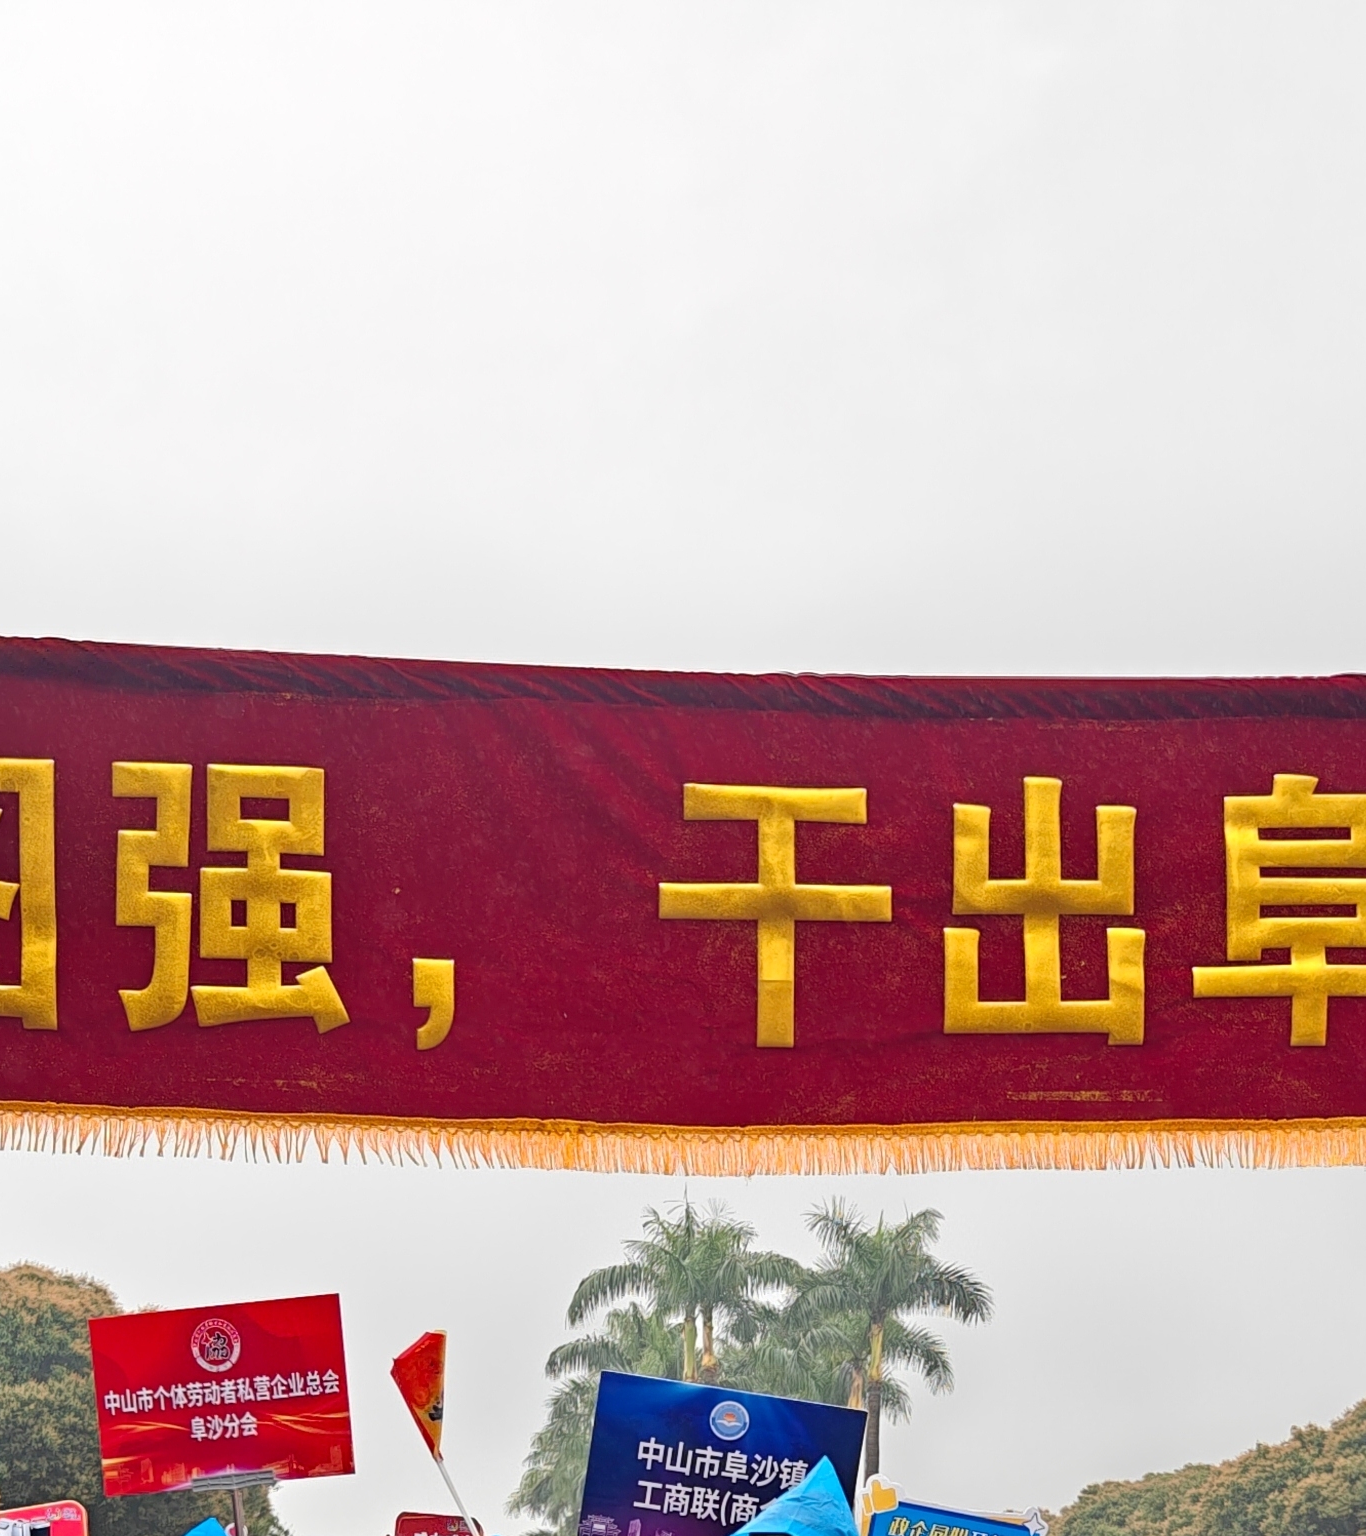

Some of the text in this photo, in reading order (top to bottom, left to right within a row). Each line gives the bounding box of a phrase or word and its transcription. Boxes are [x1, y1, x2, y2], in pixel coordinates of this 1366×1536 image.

[104, 1369, 340, 1416] 中山市个体劳动者私营企业总会
[190, 1412, 258, 1441] 阜沙分会
[637, 1437, 809, 1491] 中山市阜沙镇
[633, 1480, 775, 1526] 工商联(商
